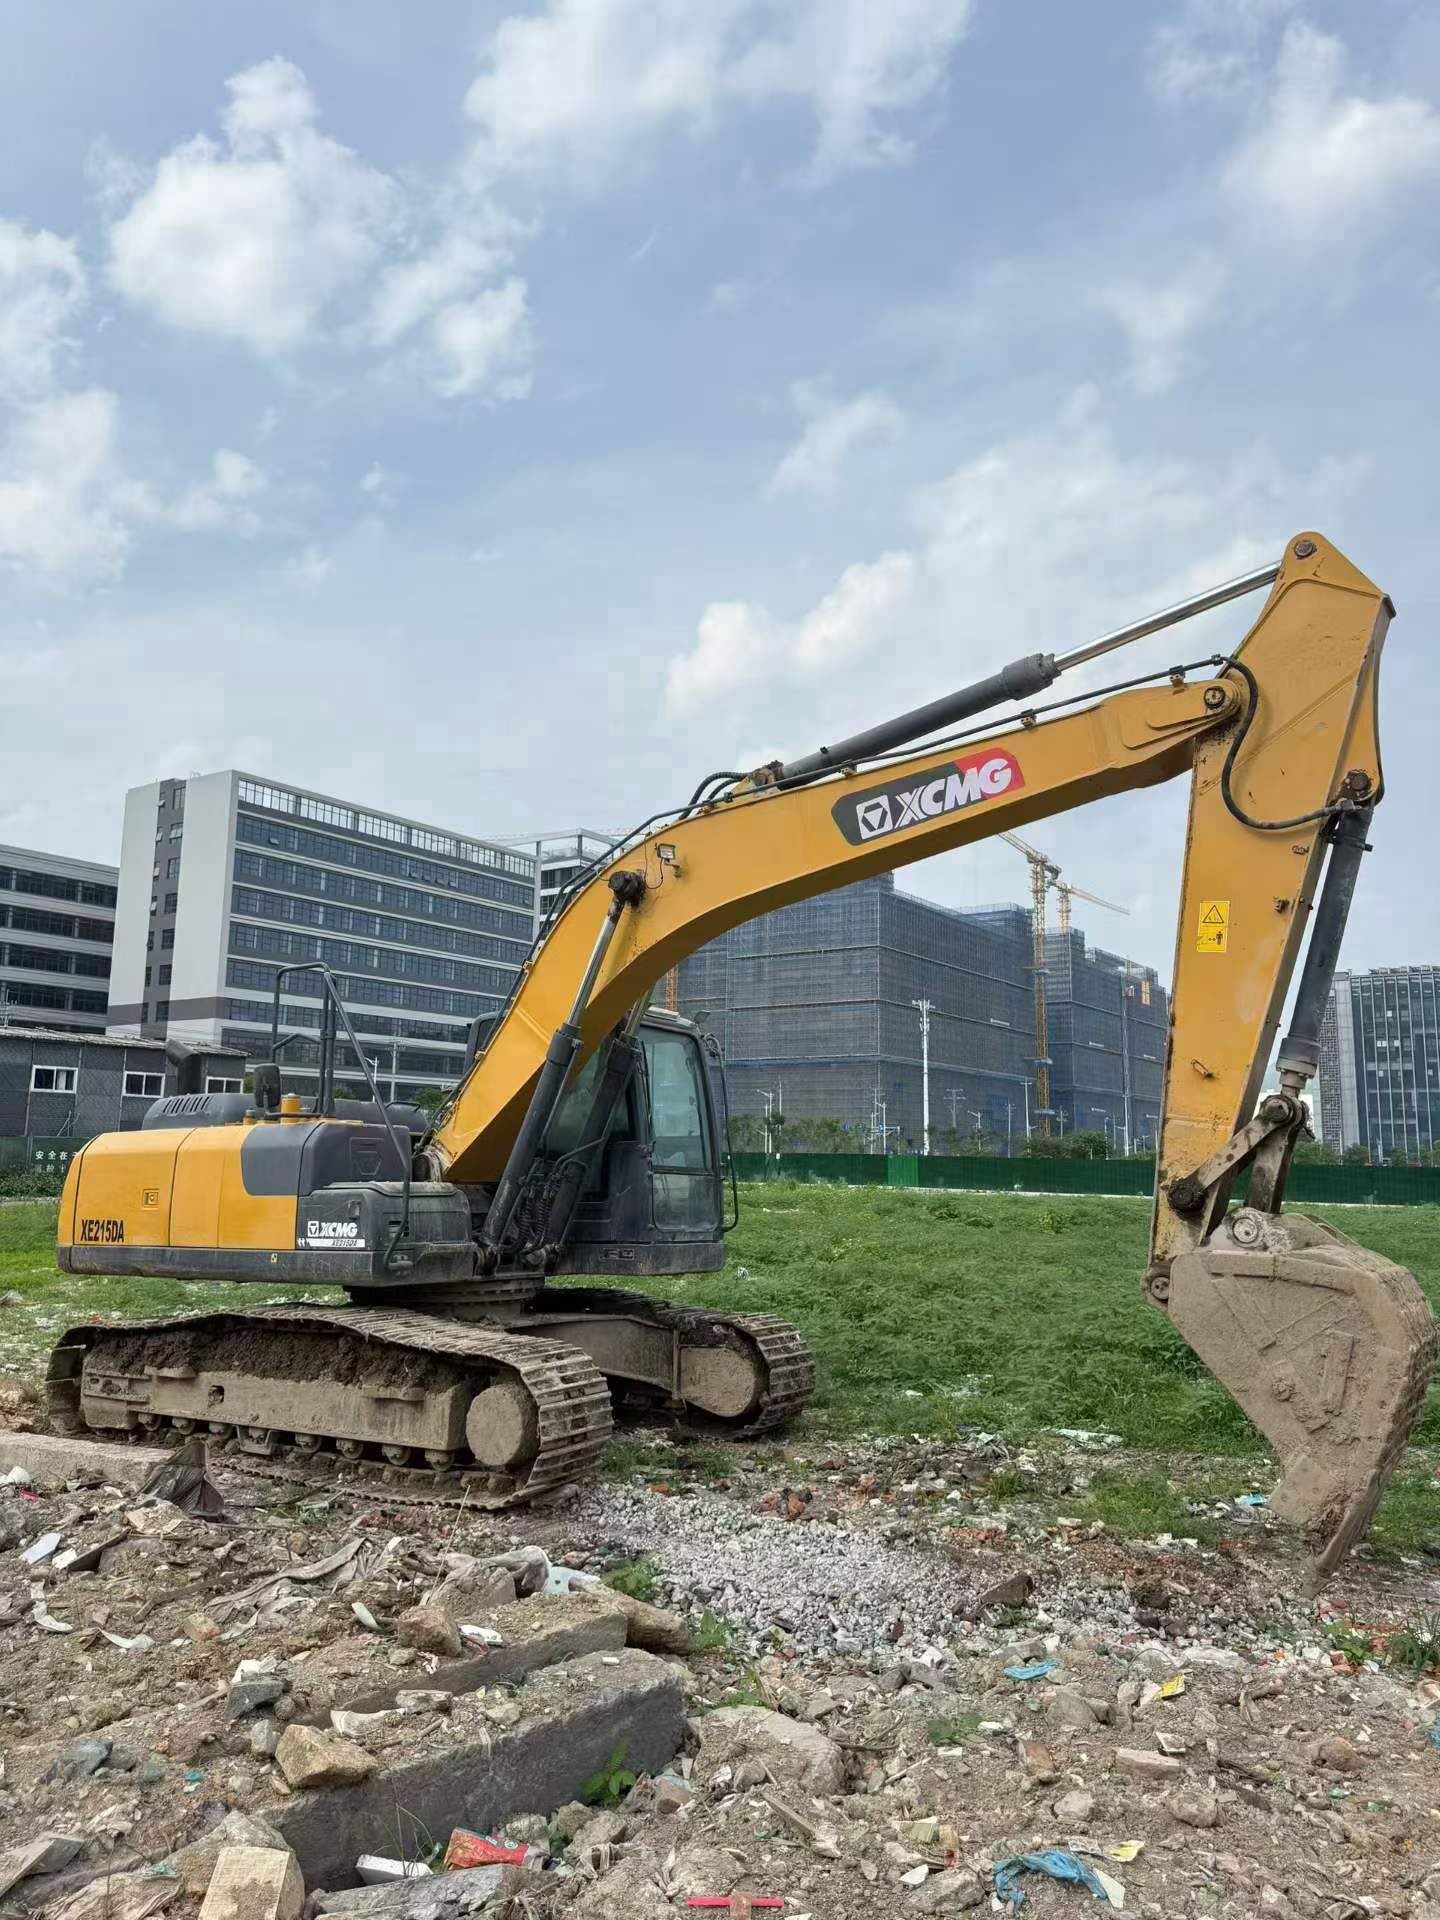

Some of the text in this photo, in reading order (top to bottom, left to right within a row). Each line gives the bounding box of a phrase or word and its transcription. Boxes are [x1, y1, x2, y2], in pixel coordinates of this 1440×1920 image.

[894, 758, 1012, 829] XCMG
[80, 1219, 124, 1243] XE215DA
[320, 1222, 358, 1237] XCMG
